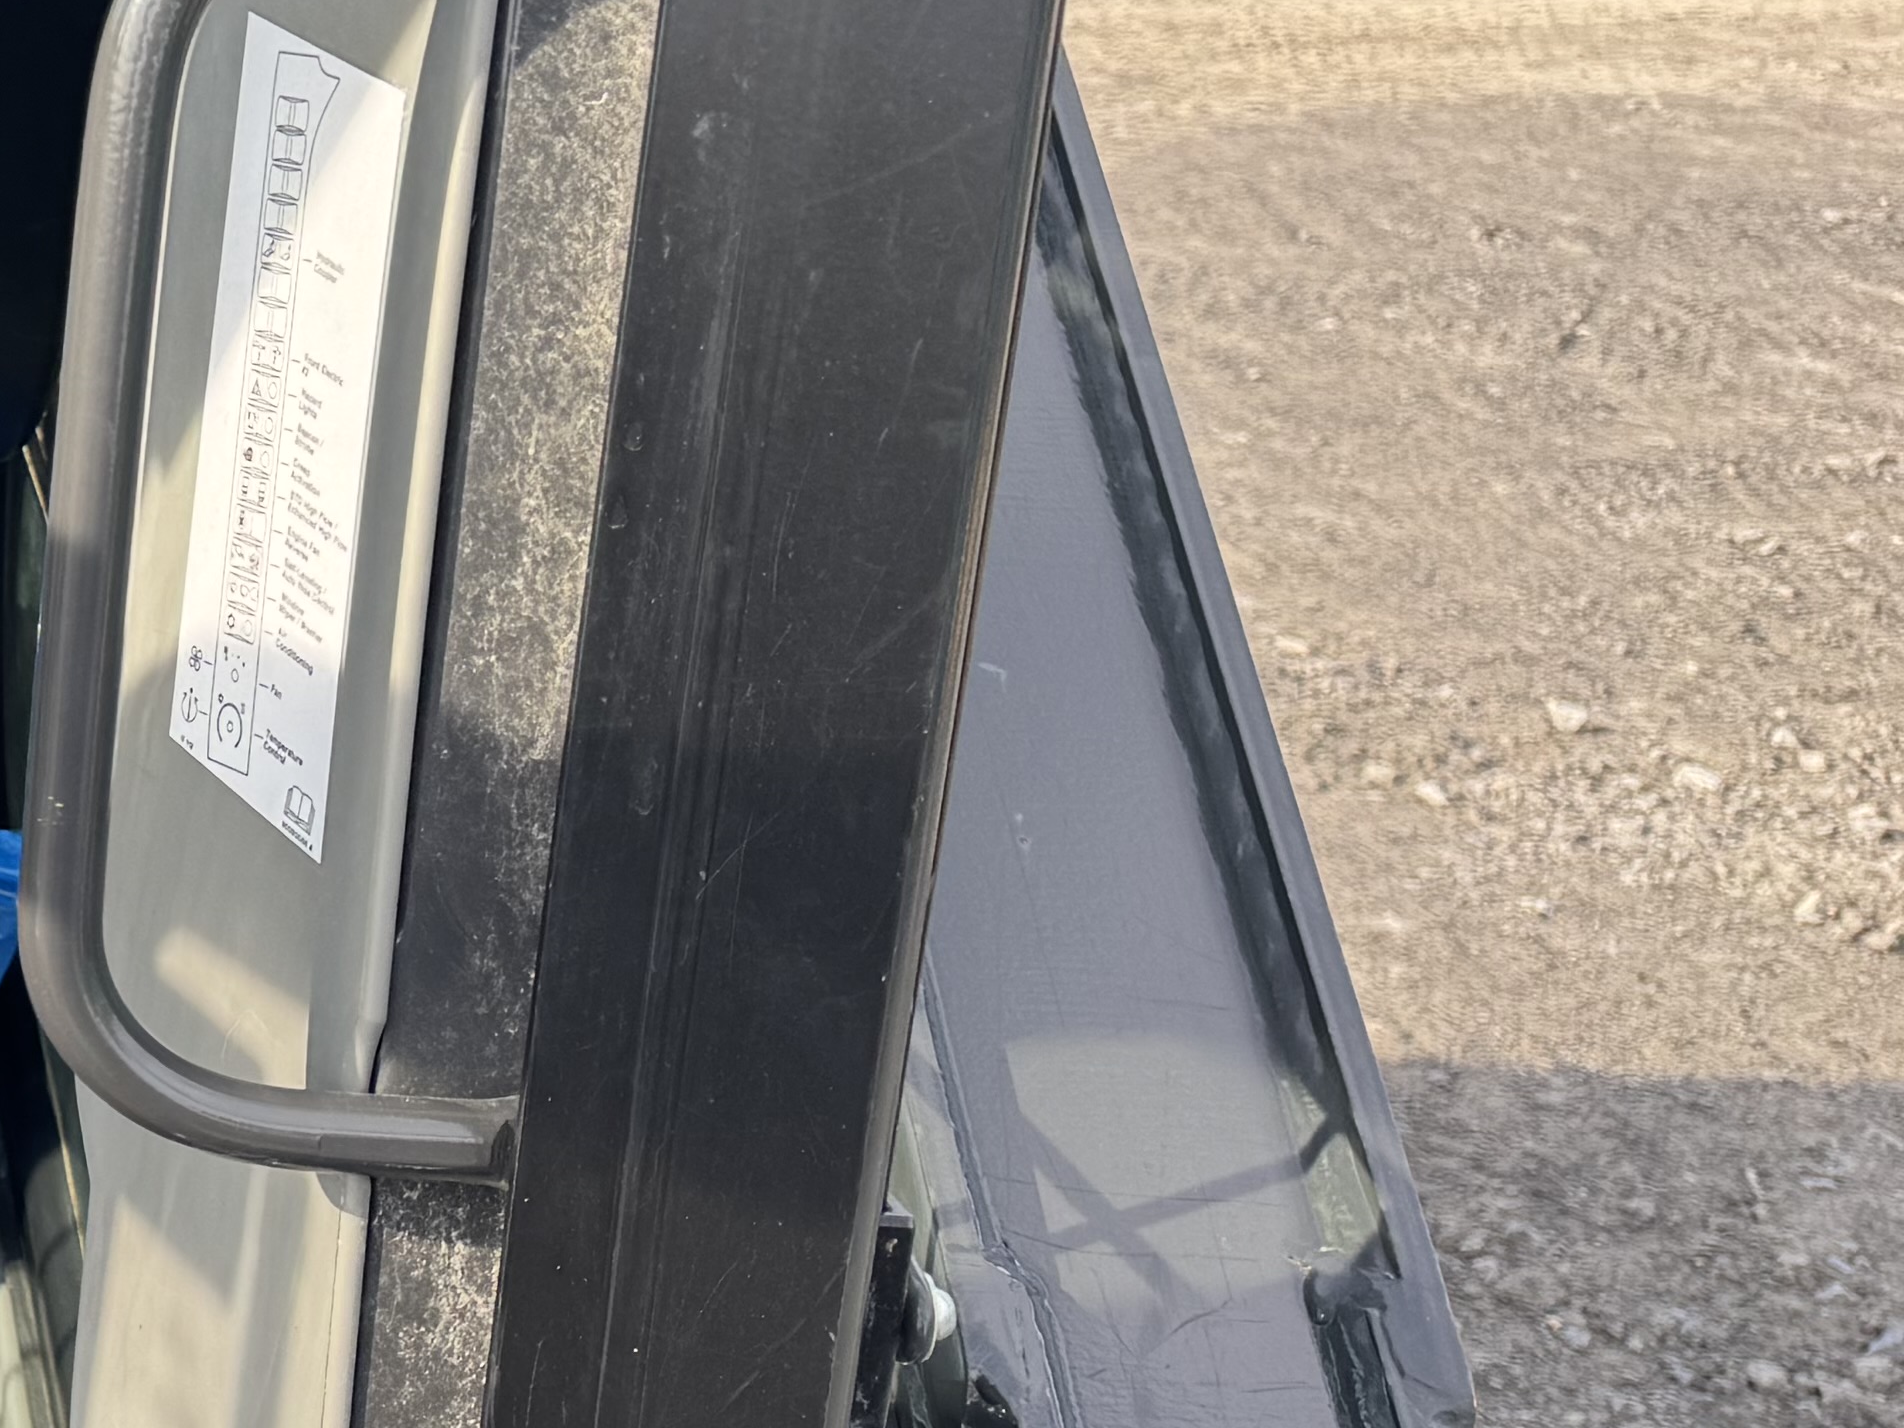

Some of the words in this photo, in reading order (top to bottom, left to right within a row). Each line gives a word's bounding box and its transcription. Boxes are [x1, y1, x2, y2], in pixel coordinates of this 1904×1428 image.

[271, 683, 282, 699] Fan
[263, 737, 287, 764] Control
[266, 728, 304, 766] Temperature
